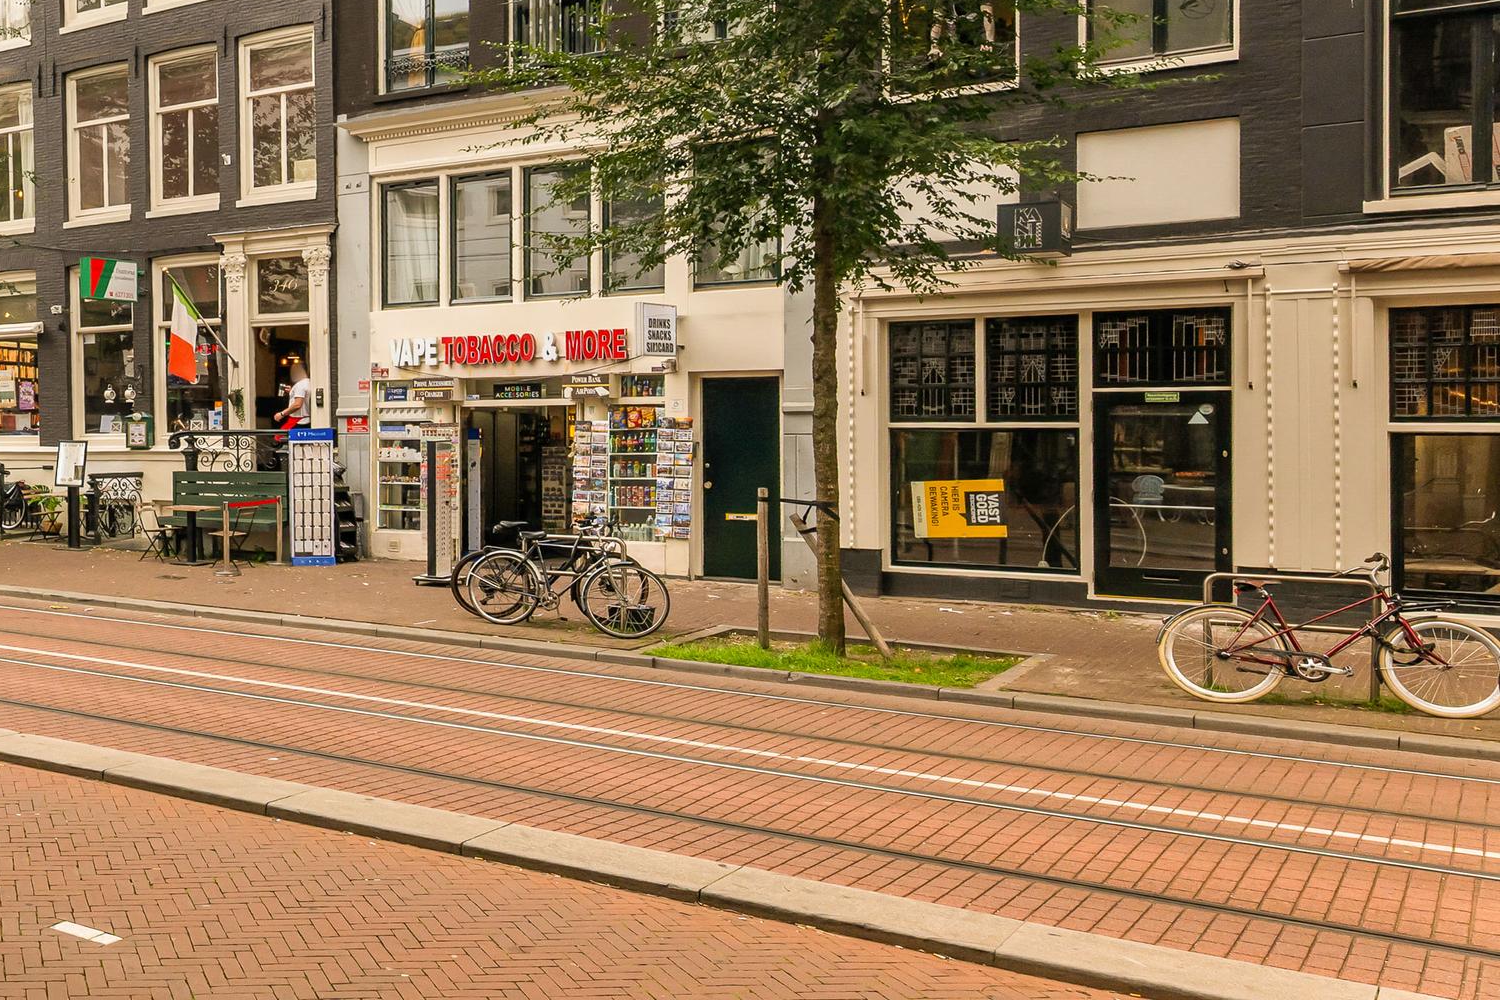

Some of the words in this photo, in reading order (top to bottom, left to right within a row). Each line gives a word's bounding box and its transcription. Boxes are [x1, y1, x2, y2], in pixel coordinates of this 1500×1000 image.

[648, 318, 671, 329] DRINKS
[647, 330, 672, 341] SNACKS
[389, 337, 438, 367] VAPE
[441, 333, 536, 364] TOBACCO
[543, 332, 558, 362] &
[565, 328, 628, 361] MORE
[646, 342, 674, 353] SIMCARD
[588, 375, 601, 383] BANK
[940, 486, 949, 516] CAMERA
[951, 486, 959, 503] HIER
[929, 487, 939, 527] BEWAKING!
[976, 494, 988, 523] GOED
[987, 494, 1000, 523] VAST
